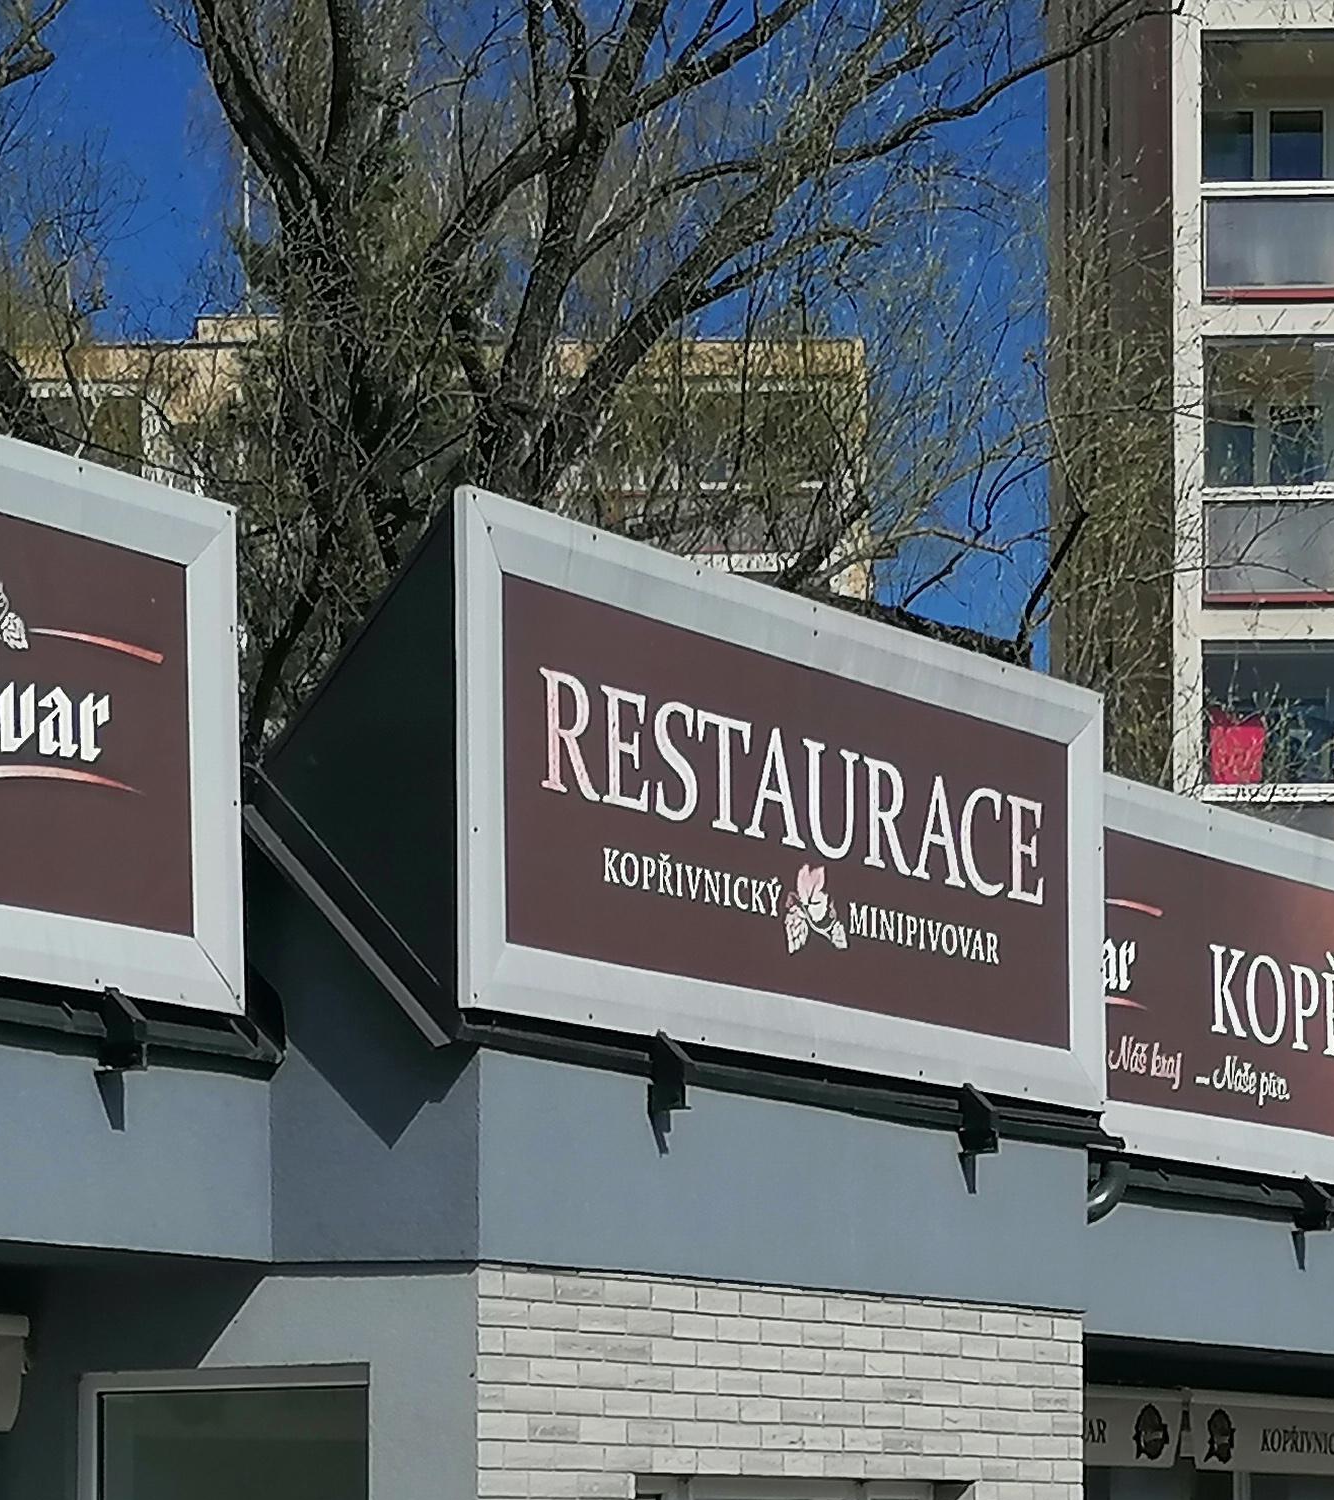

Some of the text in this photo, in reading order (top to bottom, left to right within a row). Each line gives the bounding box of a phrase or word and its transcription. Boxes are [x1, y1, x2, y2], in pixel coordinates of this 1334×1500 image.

[539, 667, 1045, 906] RESTAURACE
[603, 846, 1000, 966] KOPŘIVNICKÝ MINIPIVOVAR
